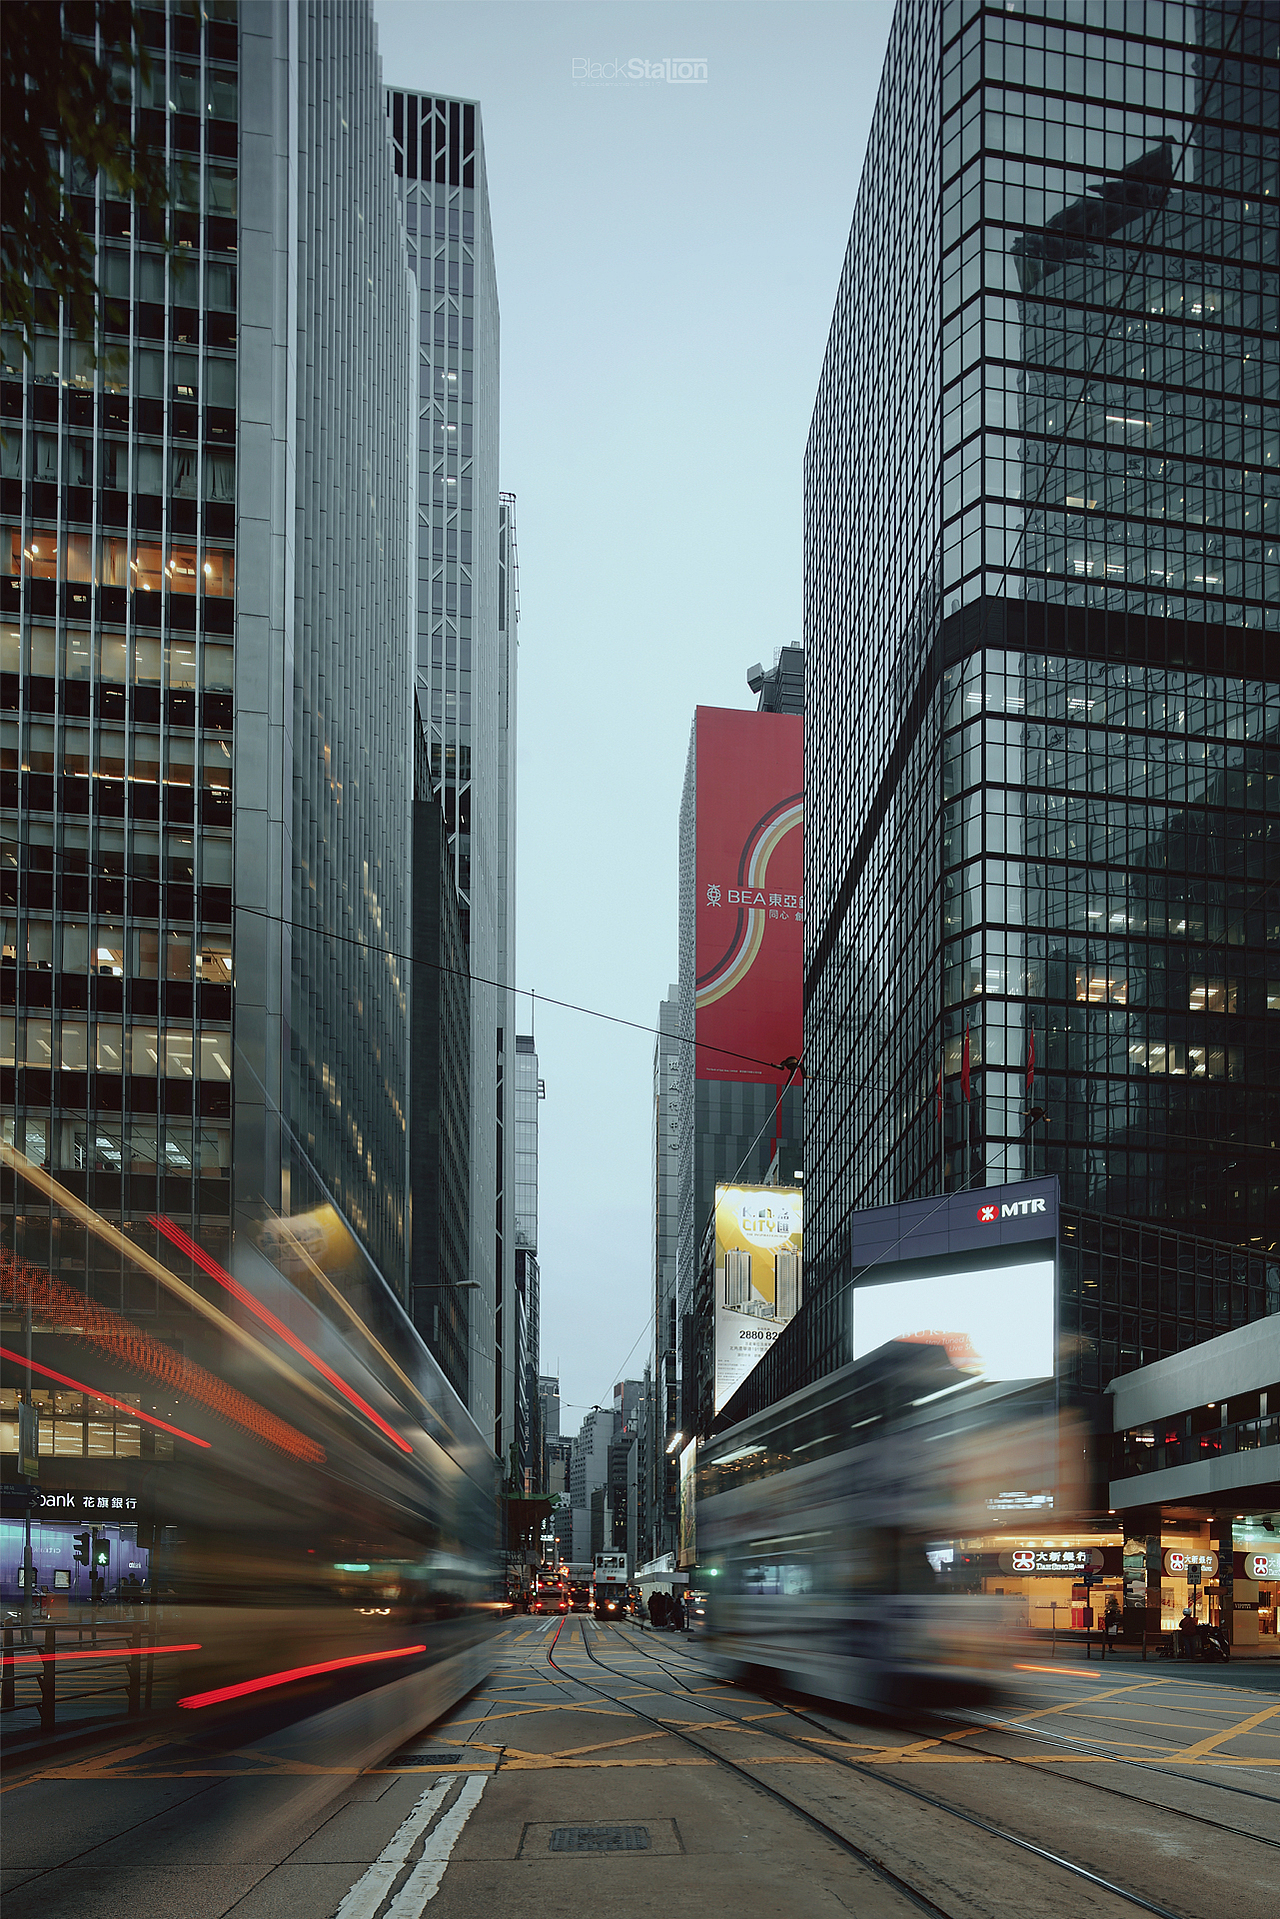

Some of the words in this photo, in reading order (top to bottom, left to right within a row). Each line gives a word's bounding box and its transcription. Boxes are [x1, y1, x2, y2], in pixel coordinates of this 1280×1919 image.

[728, 889, 766, 906] BEA
[769, 909, 789, 920] 同心
[1001, 1198, 1047, 1218] MTR
[742, 1218, 776, 1232] CITY
[739, 1330, 764, 1340] 2880
[941, 1336, 965, 1345] Tuned
[948, 1344, 963, 1352] Live
[82, 1496, 138, 1509] 花旗銀行
[1035, 1551, 1086, 1562] 大新銀行
[1184, 1554, 1213, 1564] 大新銀行
